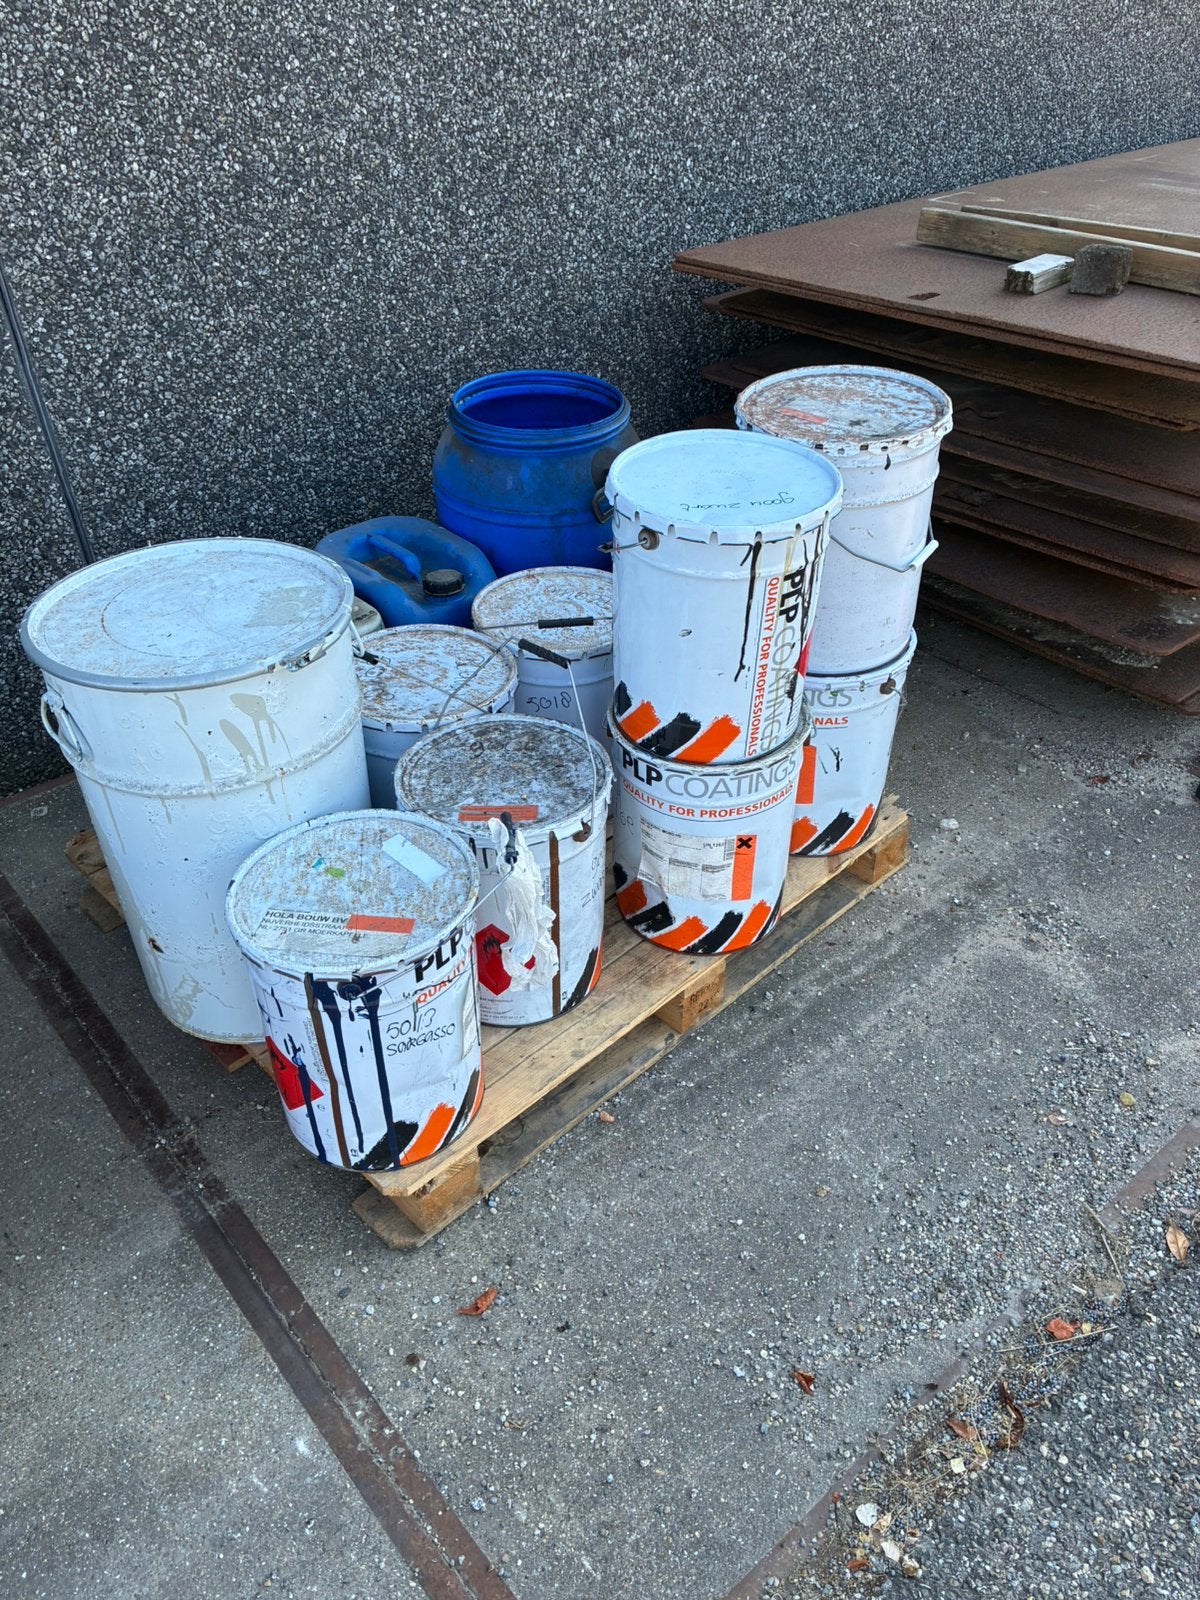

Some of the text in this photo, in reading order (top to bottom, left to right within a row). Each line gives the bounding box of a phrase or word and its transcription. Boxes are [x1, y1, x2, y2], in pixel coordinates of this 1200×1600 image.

[747, 577, 780, 757] QUALITY FOR PROFESSIONALS
[760, 567, 802, 752] PLP COATINGS
[622, 747, 796, 799] PLP COATINGS
[622, 778, 794, 818] QUALITY FOR PROFESSIONALS
[265, 911, 294, 919] HOLA
[297, 914, 331, 923] BOUW
[413, 927, 464, 983] PLP
[416, 960, 465, 1004] QUALITY
